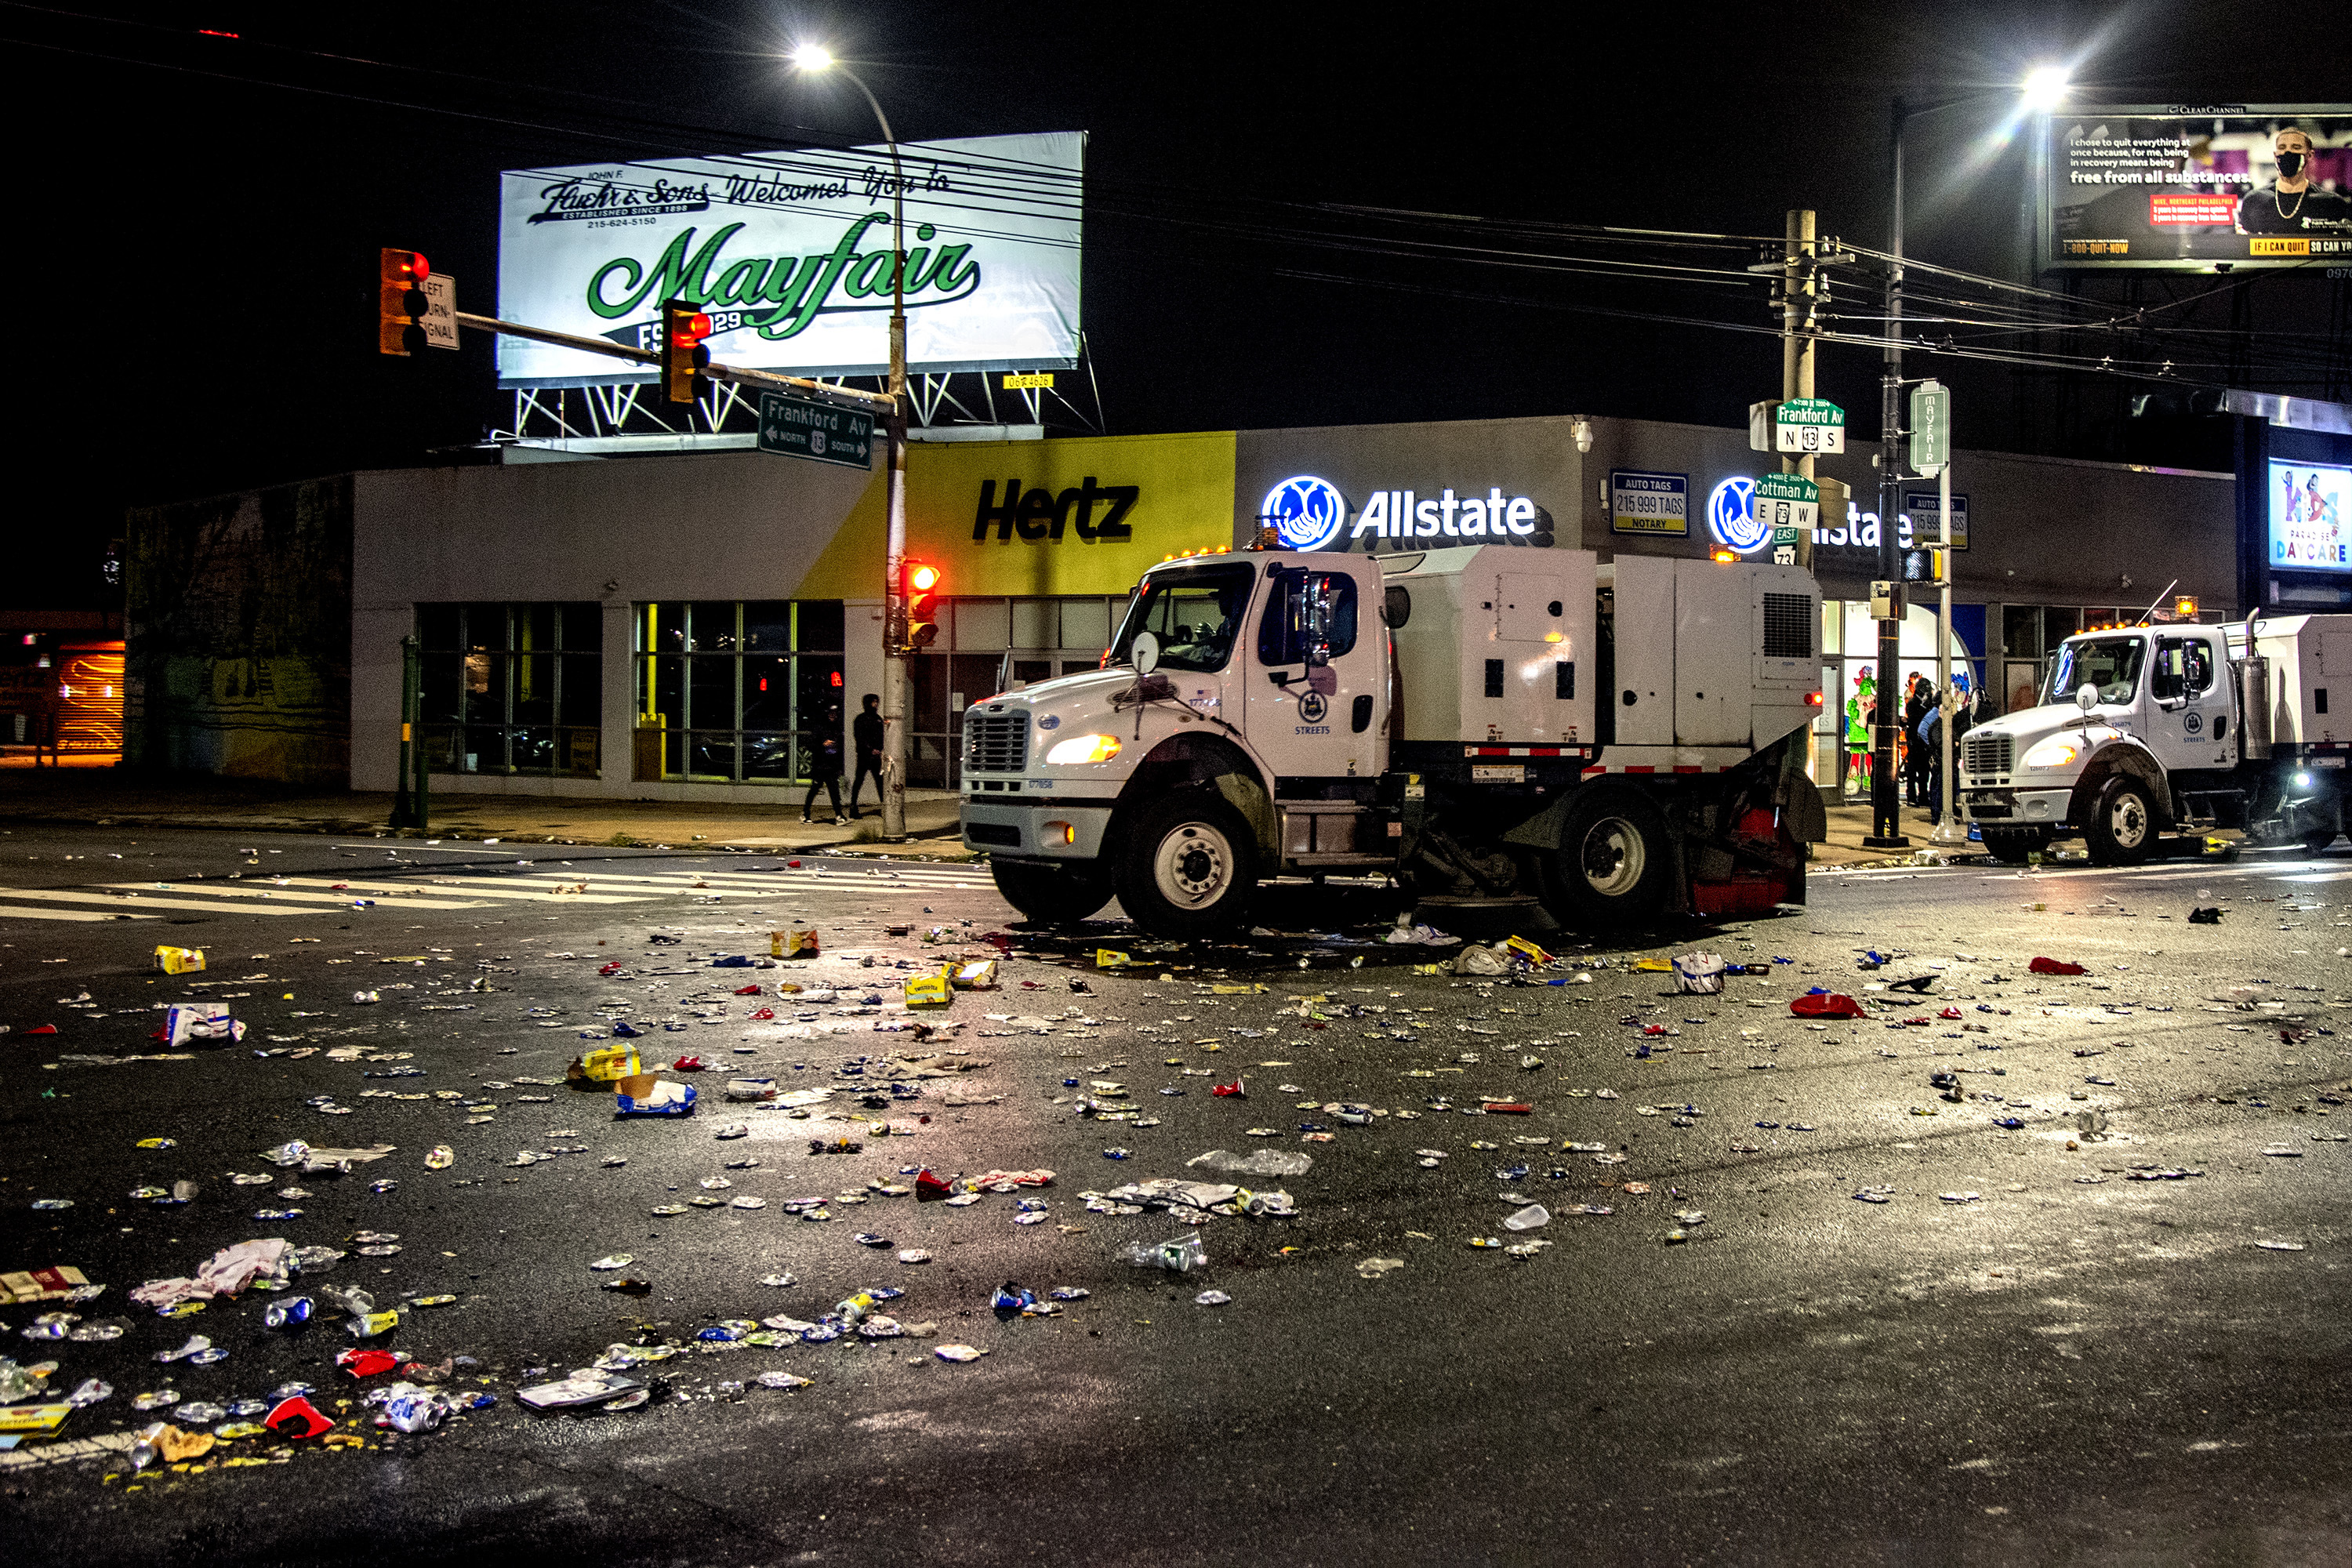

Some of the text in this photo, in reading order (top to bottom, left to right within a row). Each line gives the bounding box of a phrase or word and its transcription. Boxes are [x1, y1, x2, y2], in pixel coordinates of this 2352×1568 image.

[2114, 139, 2131, 149] quit
[2132, 139, 2180, 149] everything
[2093, 149, 2130, 158] because,
[2164, 149, 2189, 158] being
[2081, 159, 2118, 168] recovery
[2149, 158, 2175, 169] being
[589, 170, 615, 180] JOHN
[2071, 170, 2252, 183] free from all substances.
[726, 162, 950, 206] Welcomes You to
[623, 190, 641, 205] &
[646, 179, 710, 205] Sons
[562, 205, 688, 220] ESTABLISHED SINCE 1898
[588, 217, 656, 229] 215-624-5150
[2255, 242, 2261, 251] IF
[2270, 242, 2285, 251] CAN
[2287, 242, 2305, 252] QUIT
[2310, 241, 2321, 252] SO
[2323, 241, 2339, 252] CAN
[2342, 241, 2352, 252] YO
[587, 212, 981, 341] Mayfair
[429, 303, 448, 318] URN
[638, 323, 663, 352] ES
[768, 400, 867, 436] Frankford Av
[1779, 406, 1843, 424] Frankford Av
[1925, 396, 1935, 463] MAYFAIR
[779, 430, 855, 453] NORTH 13 SOUTH
[1786, 431, 1835, 446] N 13 S
[1625, 479, 1671, 491] AUTO TAGS
[1755, 480, 1817, 499] Cottman Av
[973, 476, 1139, 539] Hertz
[1617, 495, 1683, 514] 215 999 TAGS
[1917, 499, 1936, 508] AUTO
[1349, 488, 1536, 539] Allstate
[1759, 504, 1809, 522] E 73 W
[1632, 519, 1667, 529] NOTARY
[1777, 528, 1795, 539] EAST
[2277, 540, 2347, 562] DAYCARE
[1777, 554, 1791, 564] 73
[1295, 726, 1330, 735] STREETS
